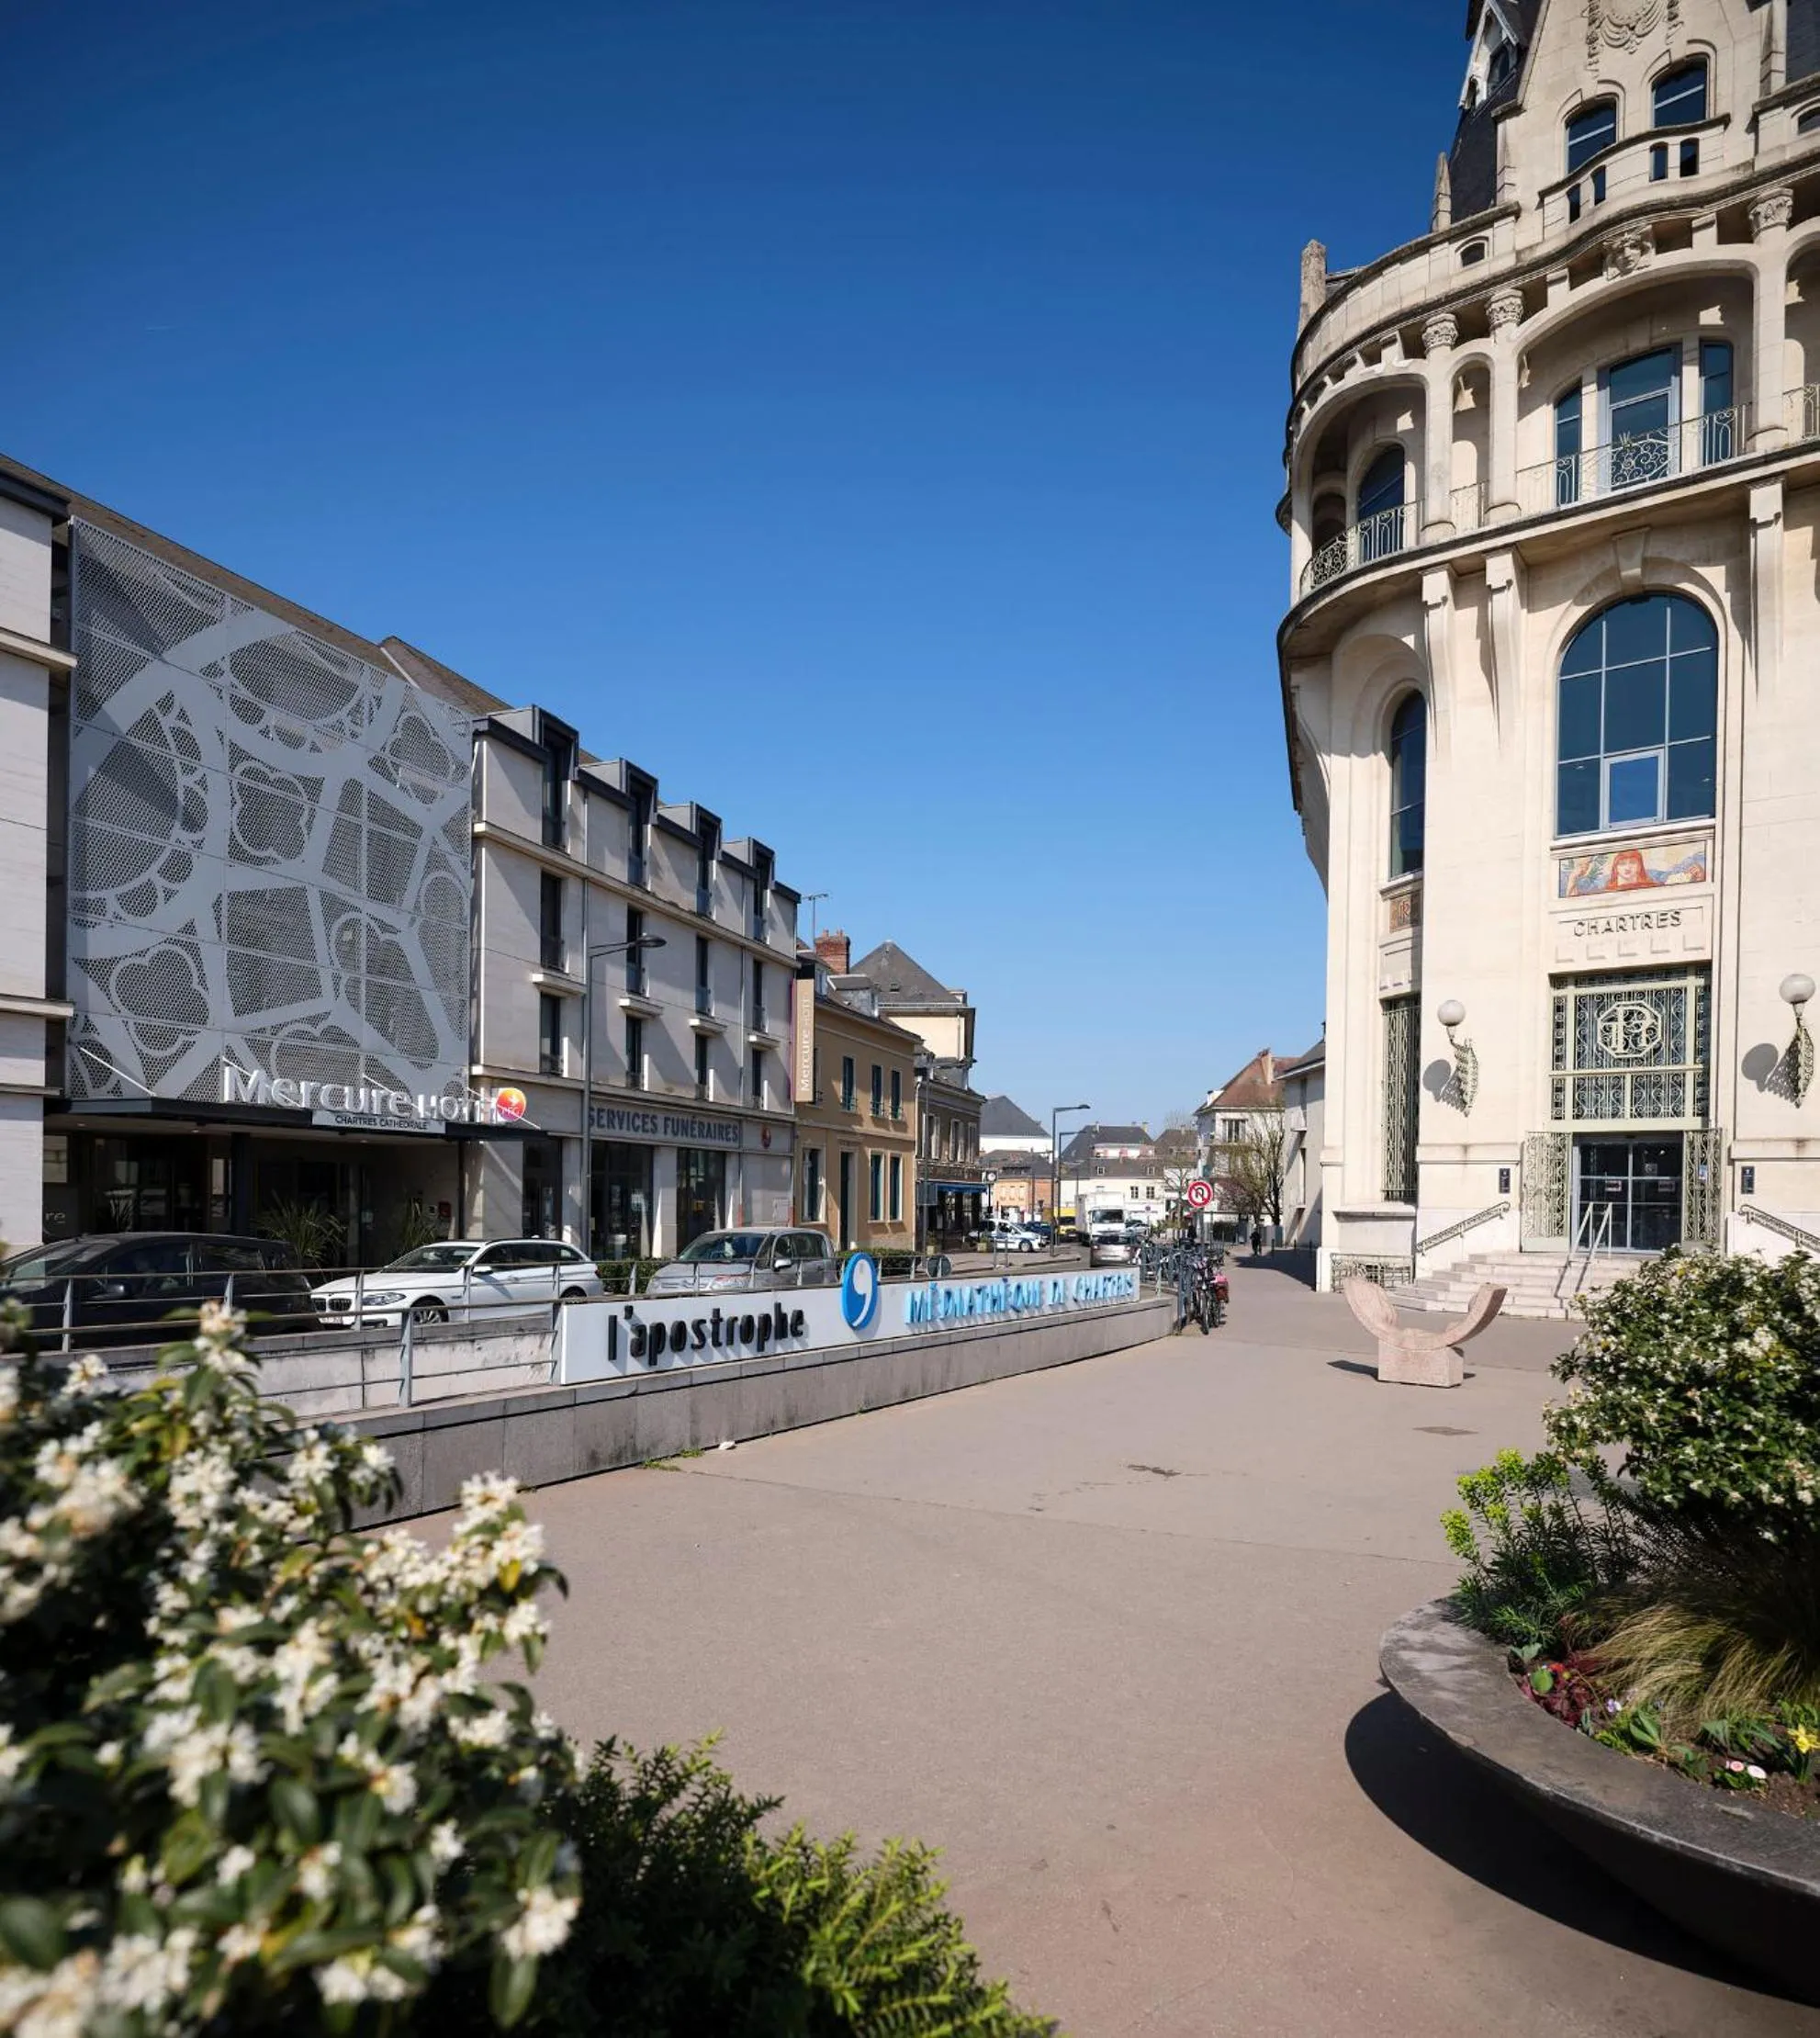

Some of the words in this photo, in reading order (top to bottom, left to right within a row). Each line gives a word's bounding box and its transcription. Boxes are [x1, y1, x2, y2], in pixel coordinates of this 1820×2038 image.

[1573, 910, 1682, 937] CHARTRES
[800, 1030, 810, 1091] Mercure
[223, 1065, 413, 1118] Mercure
[334, 1115, 377, 1126] CHARTRES
[589, 1106, 657, 1134] SERVICES
[663, 1114, 738, 1143] FUNÉRAIRES
[607, 1302, 805, 1367] l'apostrophe
